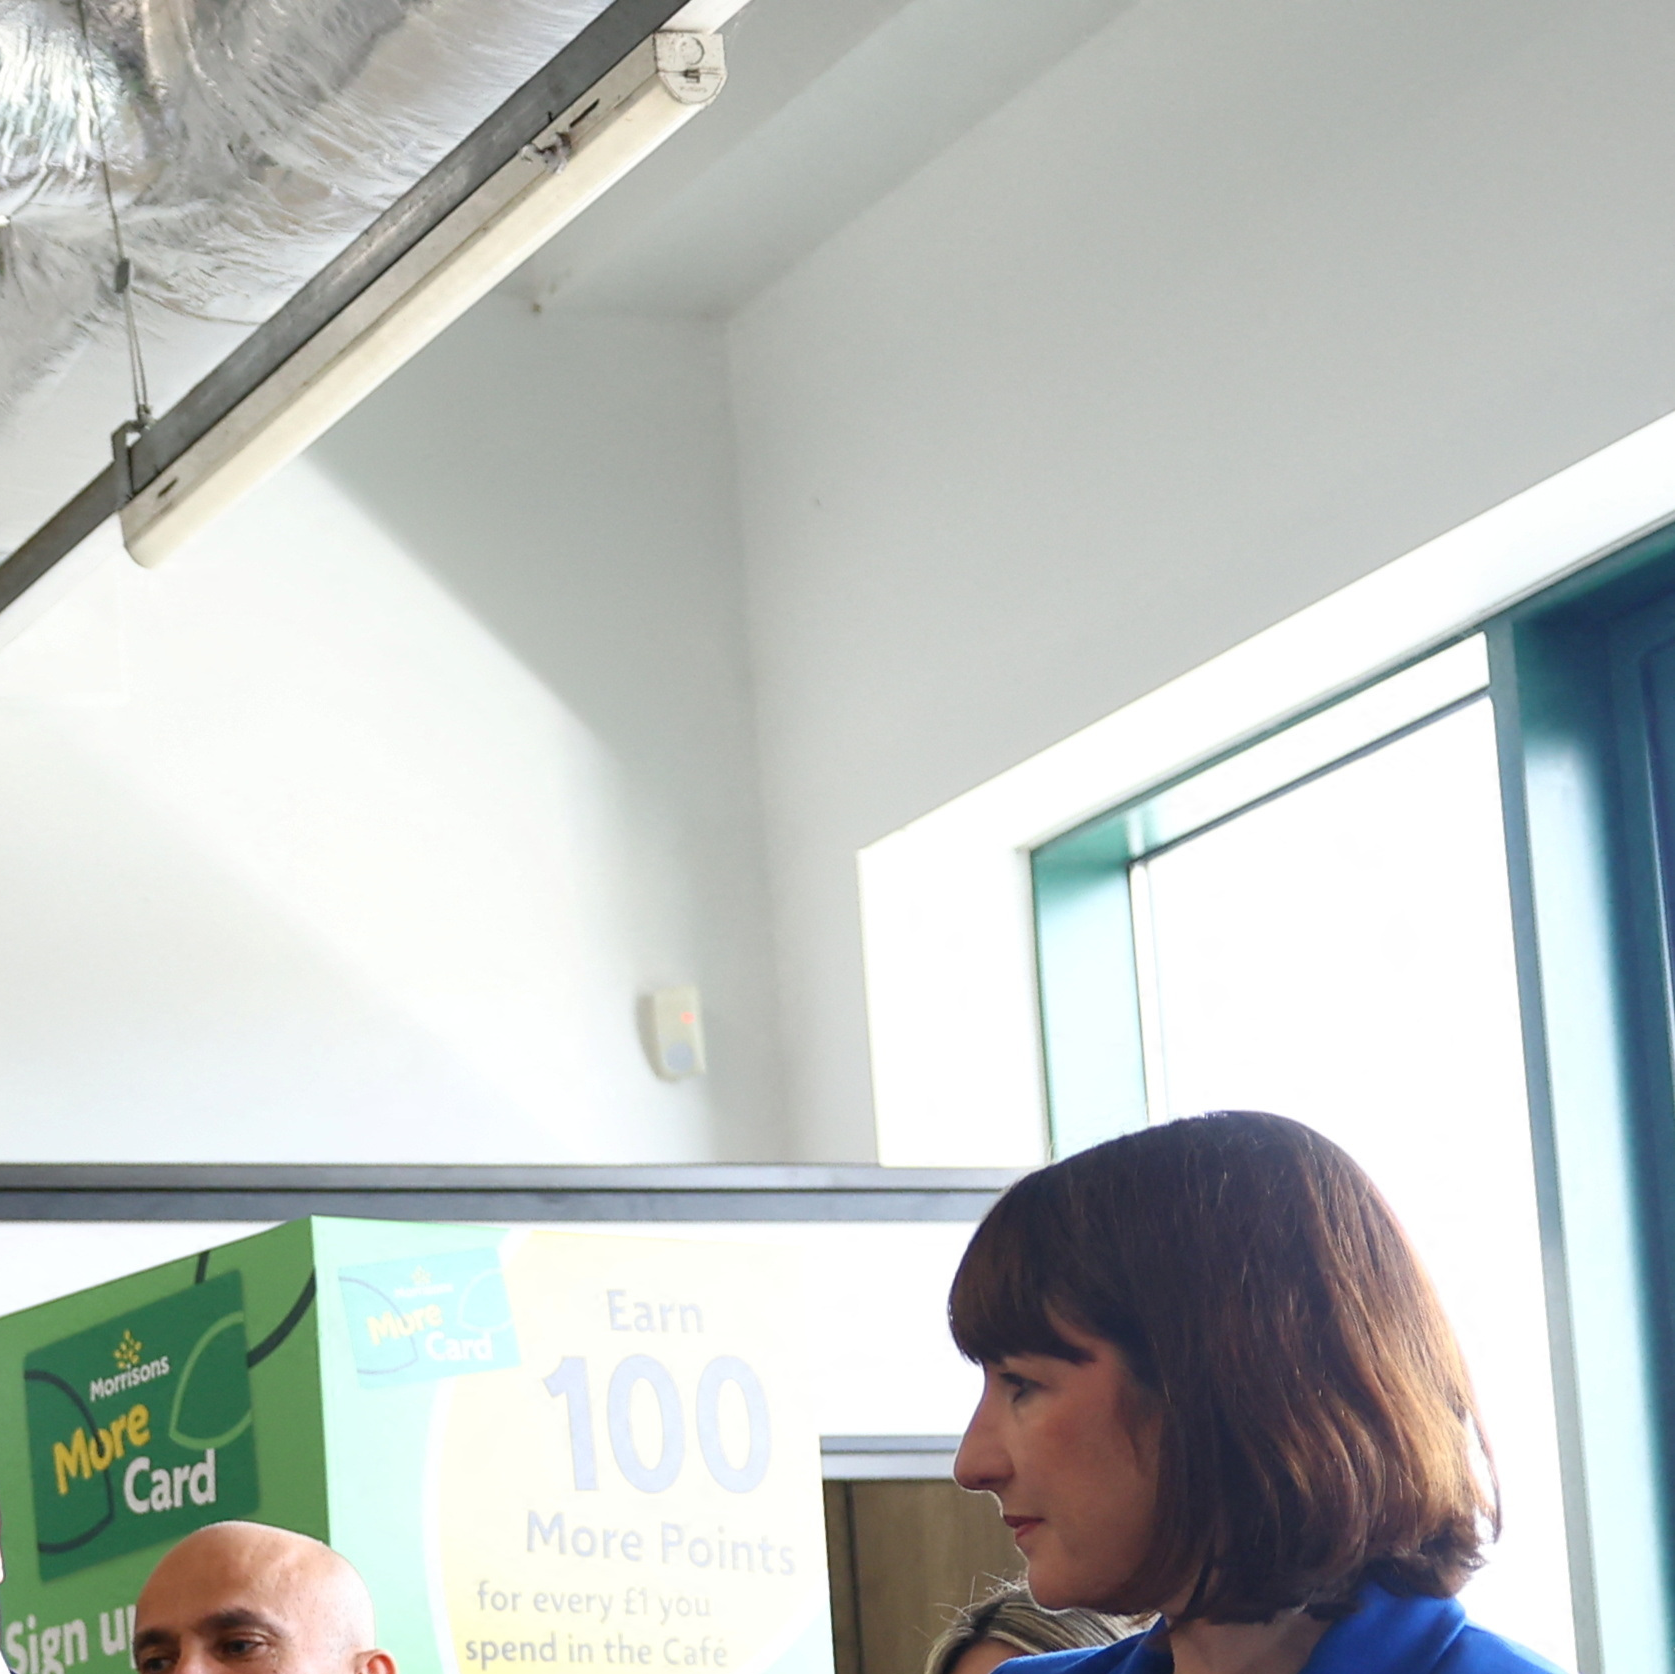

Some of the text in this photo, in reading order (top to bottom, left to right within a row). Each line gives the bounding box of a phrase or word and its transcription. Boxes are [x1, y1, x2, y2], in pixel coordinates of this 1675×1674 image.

[365, 1302, 445, 1347] More
[605, 1287, 705, 1333] Earn
[424, 1330, 494, 1361] Card
[89, 1355, 171, 1402] Morrisons
[541, 1352, 773, 1495] 100
[52, 1403, 151, 1495] More
[123, 1448, 217, 1514] Card
[525, 1509, 797, 1577] More Points
[475, 1578, 712, 1627] for every £1 you
[464, 1630, 729, 1672] spend in the Café
